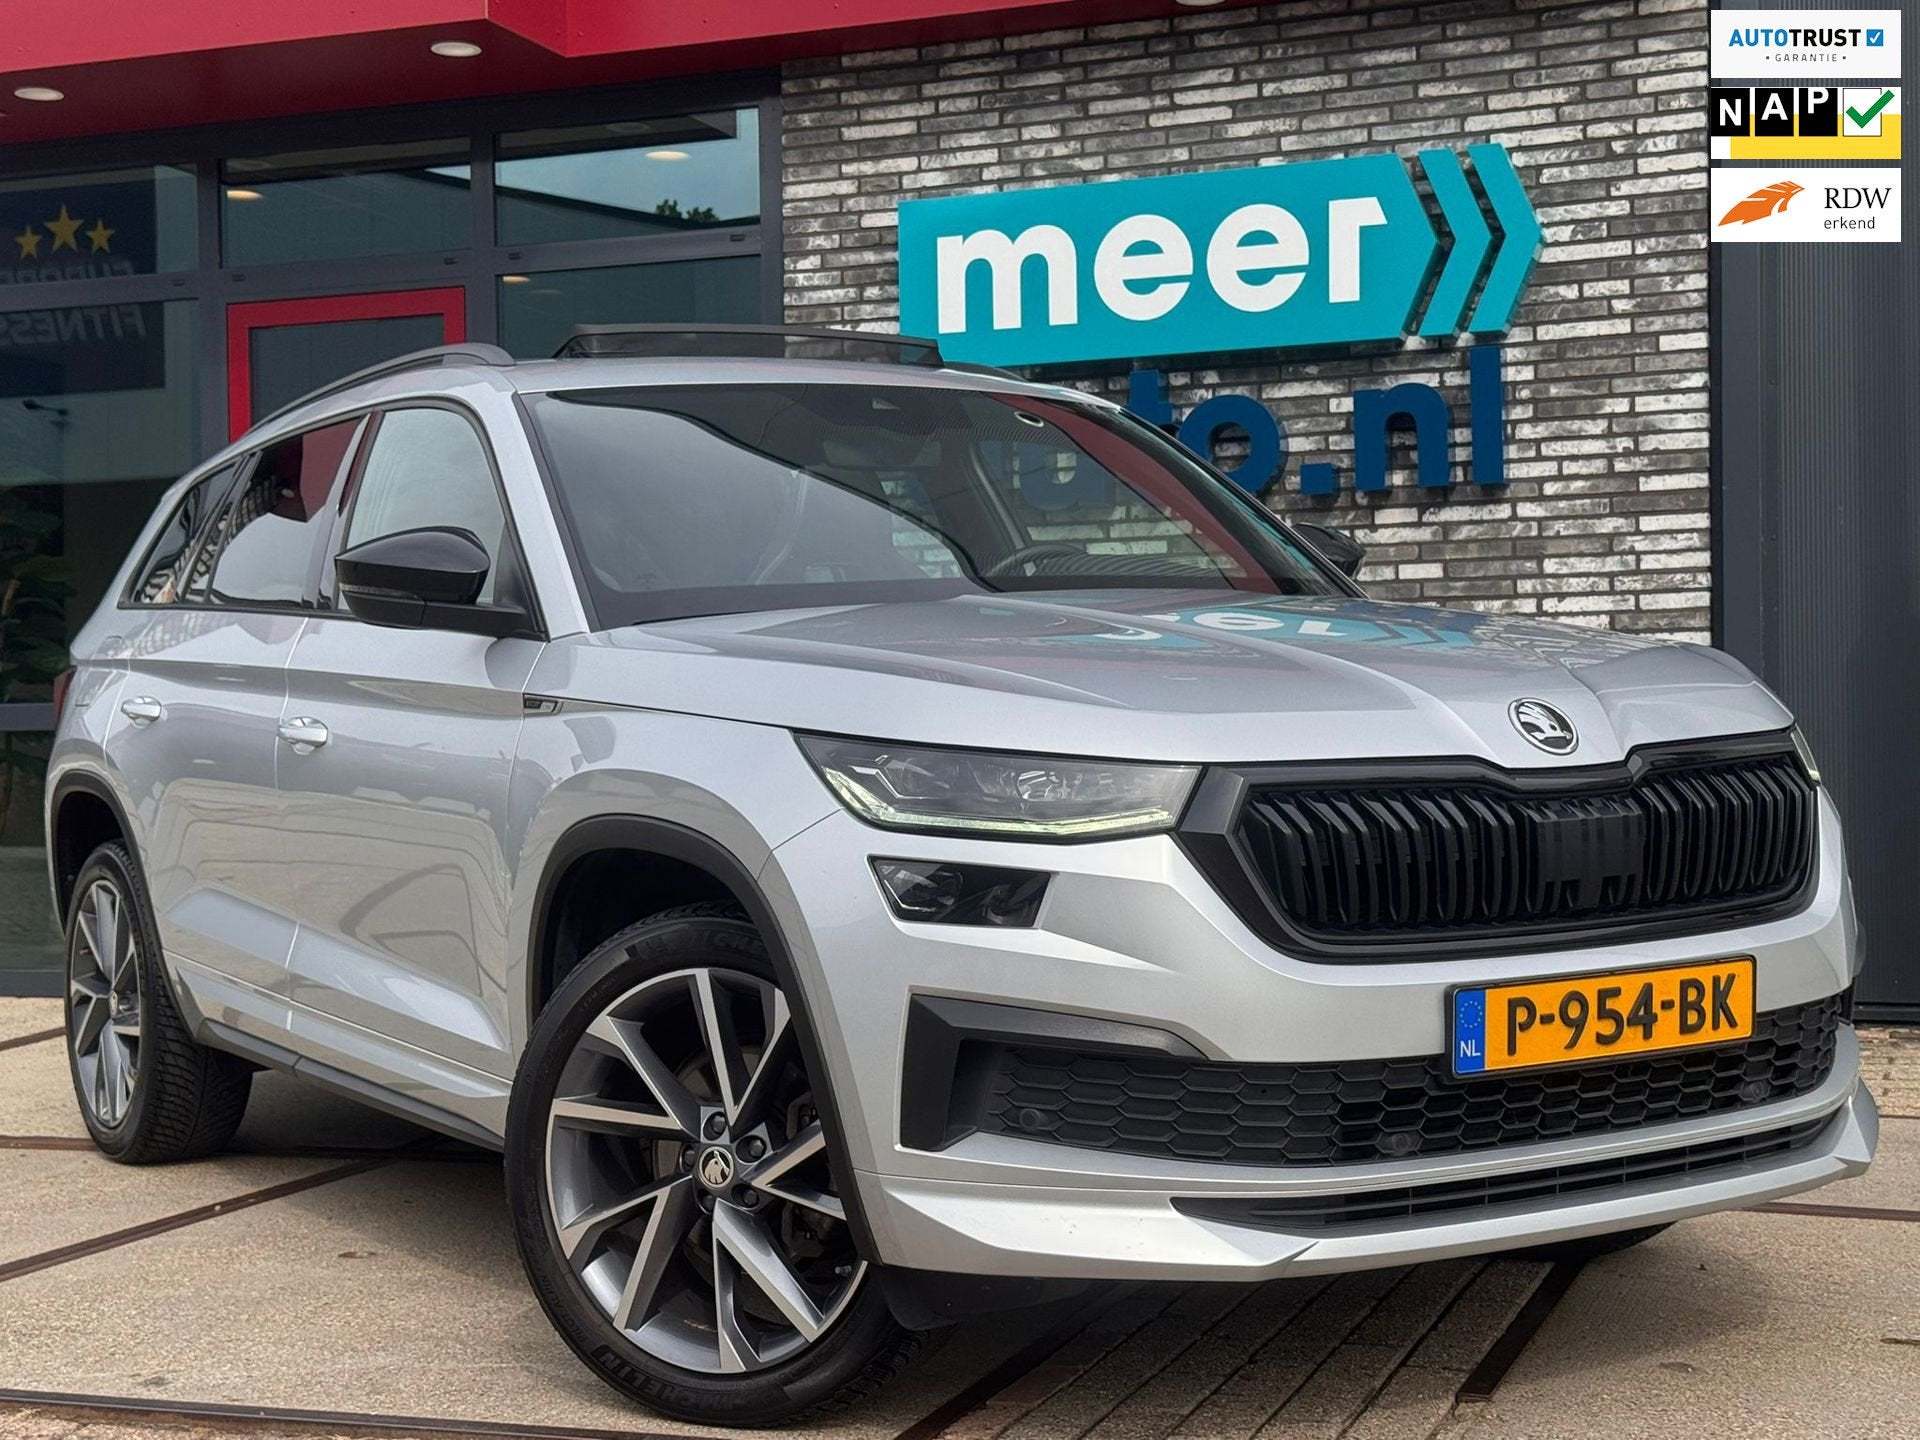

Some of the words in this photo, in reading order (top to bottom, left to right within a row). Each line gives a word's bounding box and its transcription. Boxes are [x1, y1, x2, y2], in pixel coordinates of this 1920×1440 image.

[937, 196, 1388, 334] meer
[1460, 1039, 1482, 1058] NL
[1507, 973, 1739, 1056] P-954-BK
